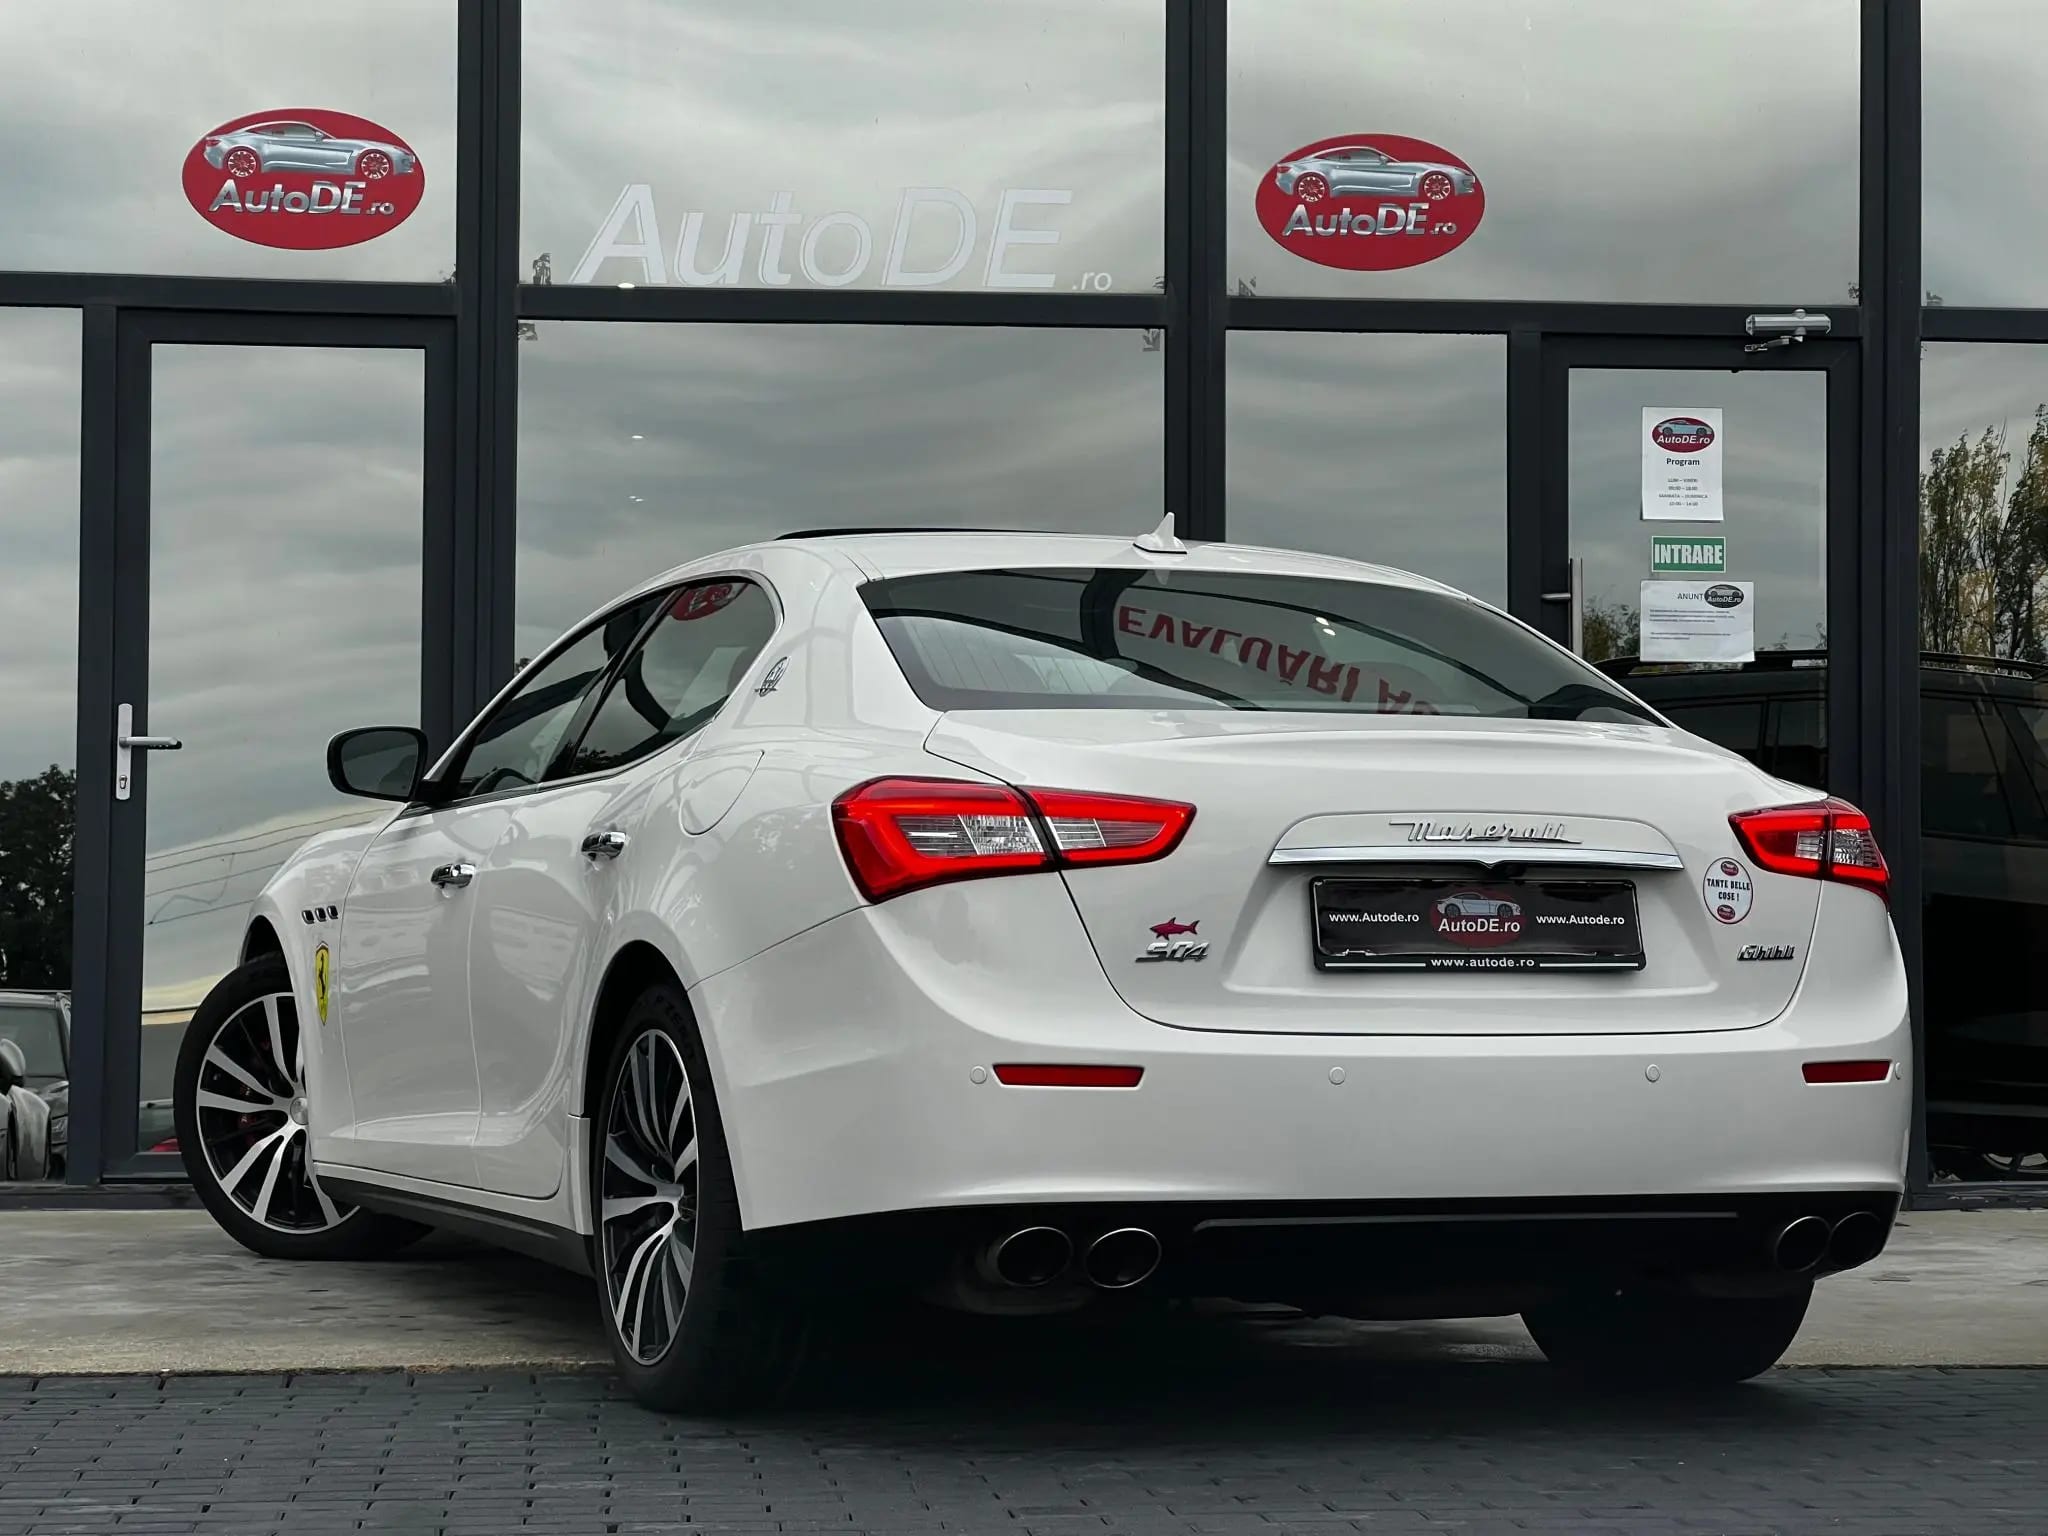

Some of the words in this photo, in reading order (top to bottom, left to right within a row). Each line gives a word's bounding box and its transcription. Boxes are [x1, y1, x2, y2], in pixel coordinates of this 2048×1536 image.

[1656, 434, 1711, 445] AutoDE.ro
[1666, 457, 1700, 467] Program
[1654, 543, 1723, 565] INTRARE
[1389, 820, 1583, 844] Maserati
[1706, 878, 1729, 889] TANTE
[1730, 880, 1751, 891] BELLE
[1718, 891, 1736, 901] COSE
[1329, 911, 1420, 923] www.Autode.ro
[1536, 913, 1625, 926] www.Autode.ro
[1438, 918, 1521, 933] AutoDE.ro
[1737, 944, 1795, 961] Ghibli
[1431, 957, 1535, 969] www.autode.ro
